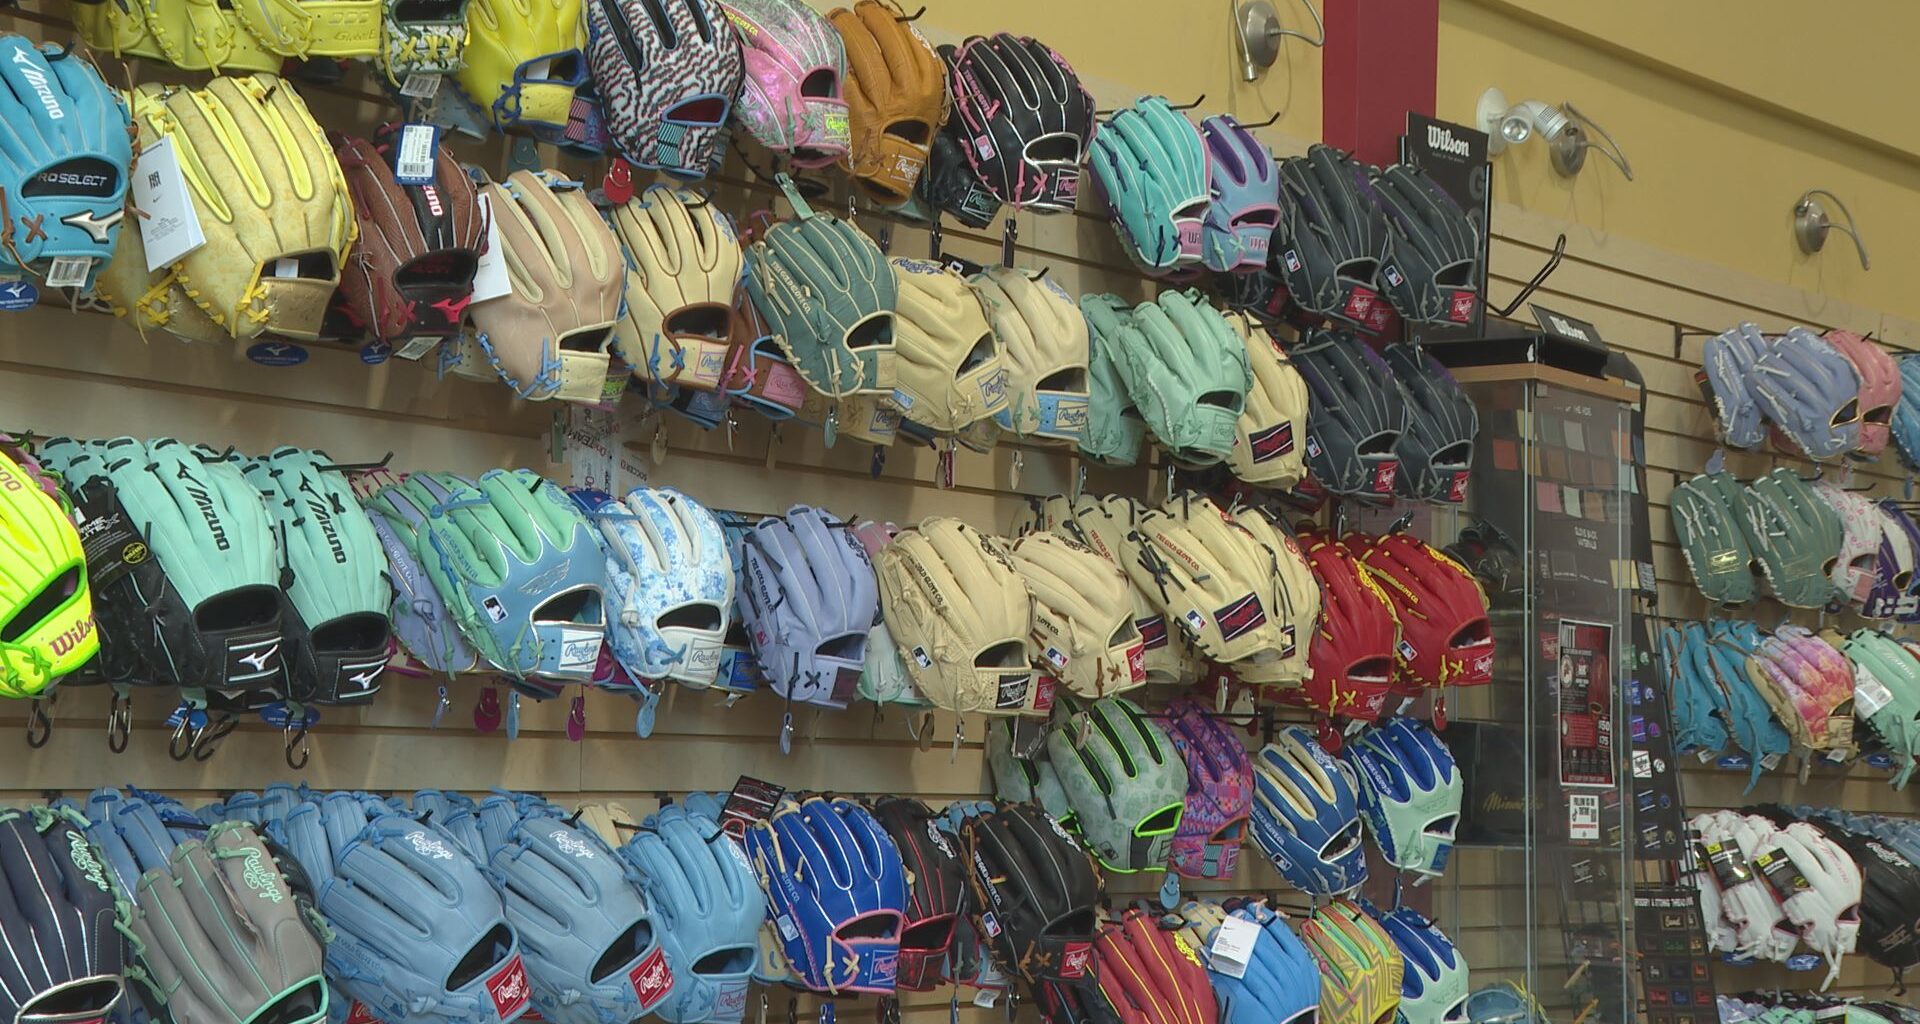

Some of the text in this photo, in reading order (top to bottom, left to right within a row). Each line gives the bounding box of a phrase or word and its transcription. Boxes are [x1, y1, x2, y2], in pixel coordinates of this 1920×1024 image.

[20, 66, 65, 121] MIZUNO
[1427, 125, 1470, 157] Wilson
[422, 185, 443, 216] ZUNO
[185, 484, 230, 551] MIZUNO
[307, 497, 347, 565] MIZUNO
[49, 610, 97, 657] Wilso
[66, 830, 109, 892] Rawlings
[405, 831, 454, 860] Rawlings
[549, 830, 595, 859] Rawlings
[240, 847, 282, 904] Rawlings
